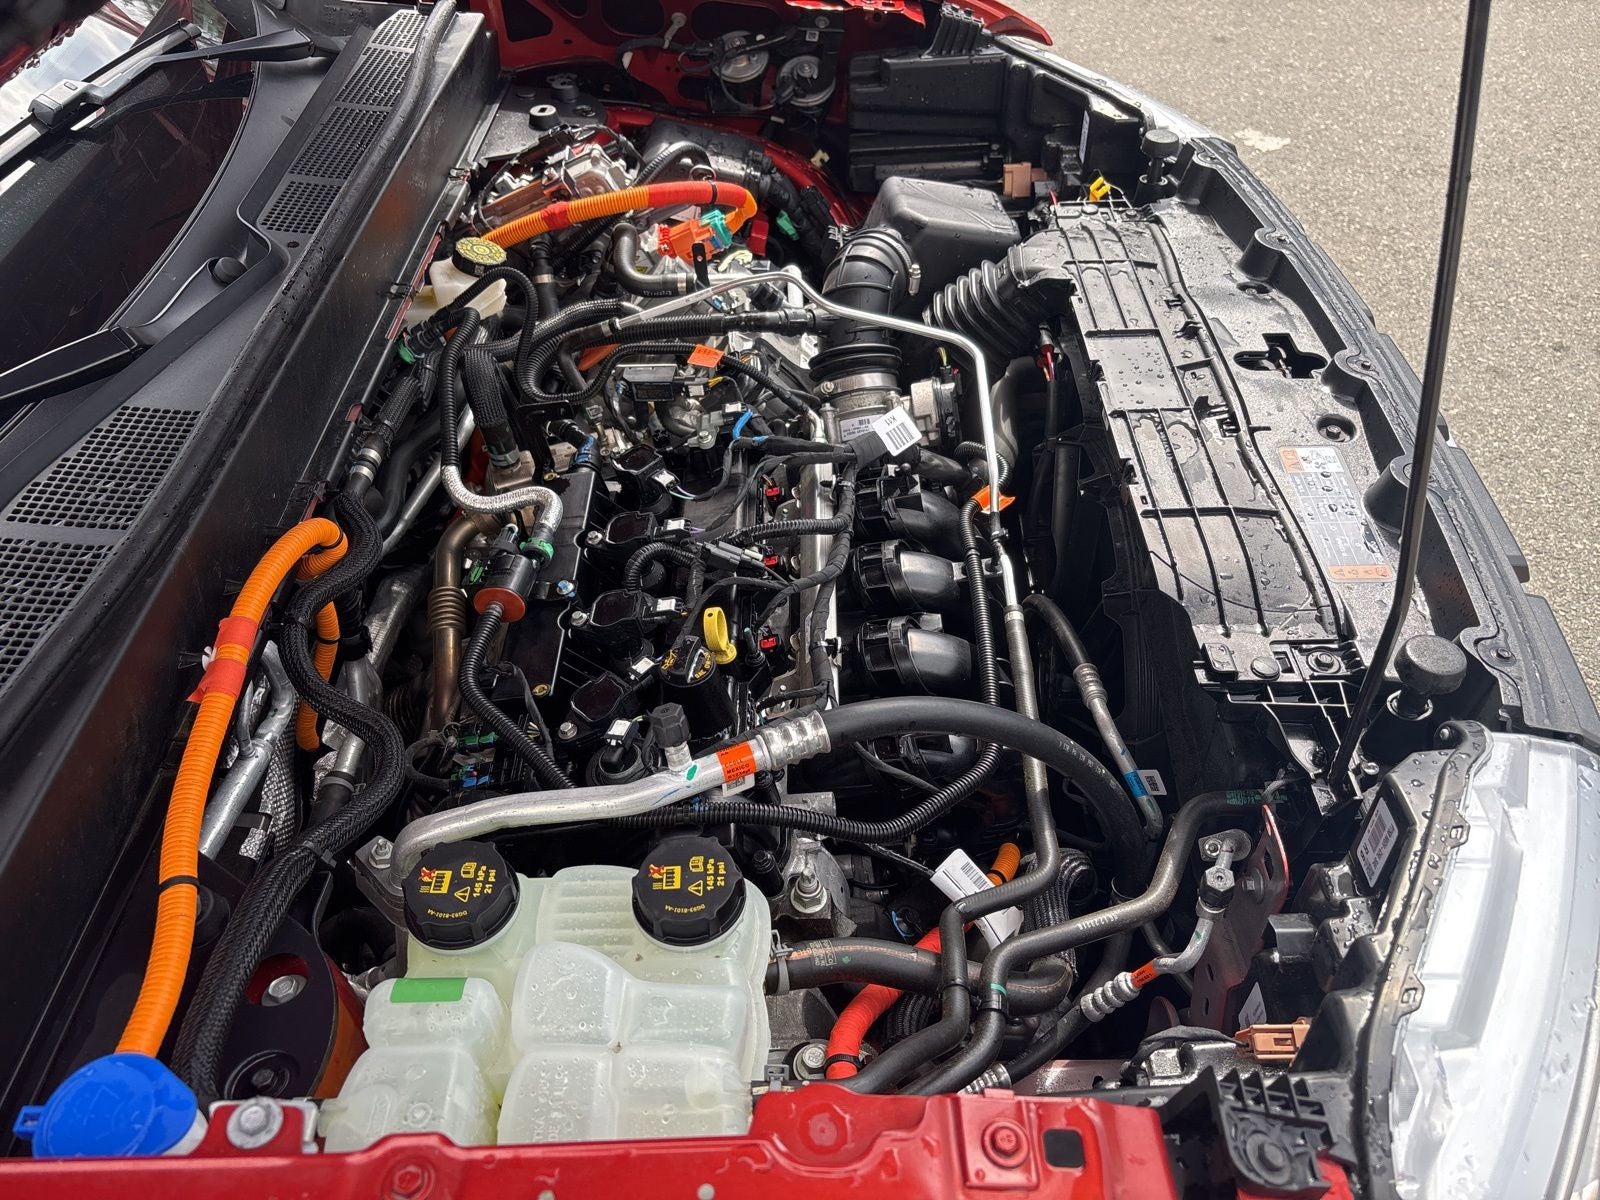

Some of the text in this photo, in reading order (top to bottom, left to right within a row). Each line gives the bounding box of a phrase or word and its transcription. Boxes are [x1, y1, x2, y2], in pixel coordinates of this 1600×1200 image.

[726, 763, 750, 774] MEXICO
[472, 865, 487, 897] 145 kPa
[706, 858, 714, 890] 145 kPa
[717, 861, 726, 887] 21 psi
[484, 883, 493, 894] 21
